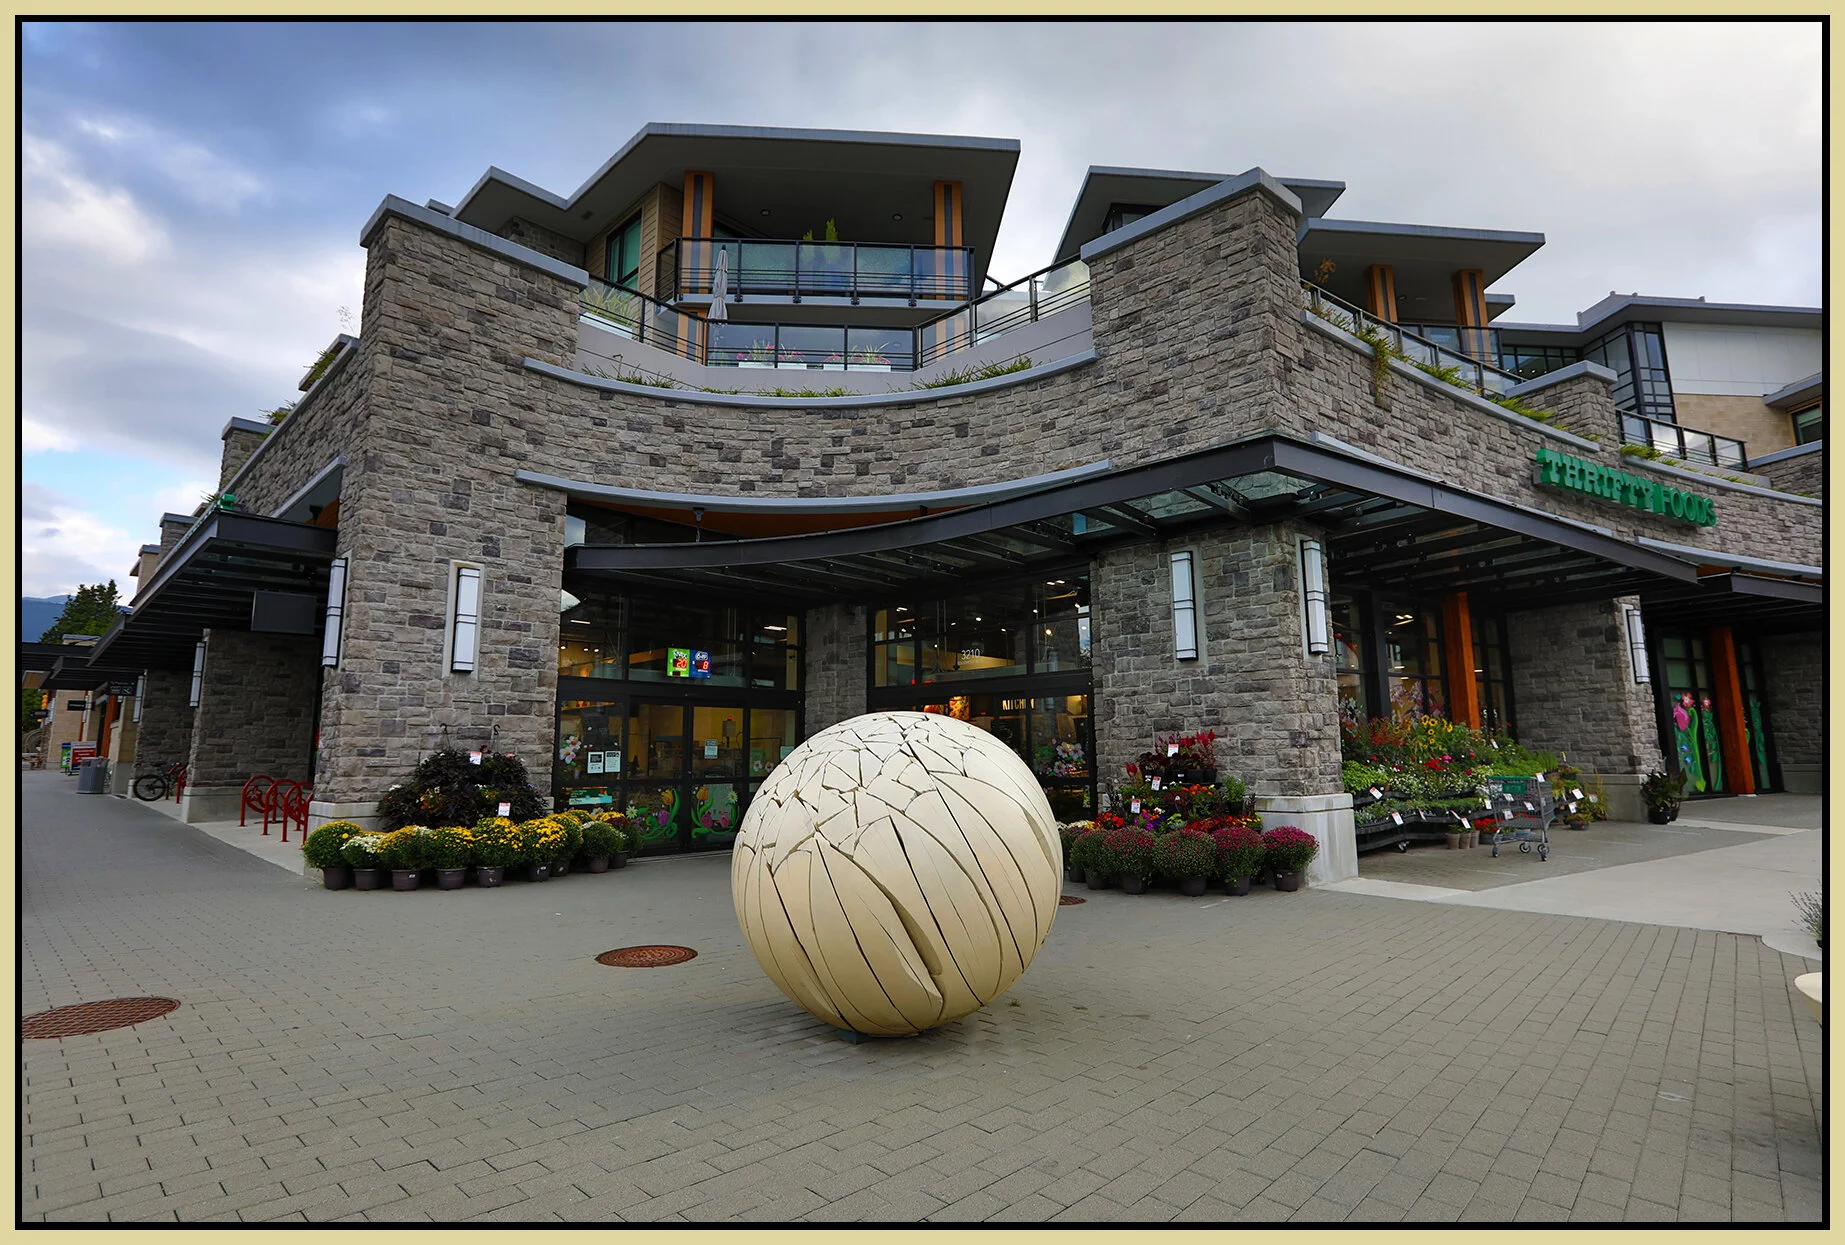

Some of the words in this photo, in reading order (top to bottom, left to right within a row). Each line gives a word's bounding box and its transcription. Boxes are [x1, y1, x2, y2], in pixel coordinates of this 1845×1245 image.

[1537, 448, 1653, 510] THRIFTY
[1652, 485, 1718, 527] FOODS
[961, 648, 981, 660] 3210
[703, 661, 709, 670] 8
[1002, 698, 1034, 710] KITCH
